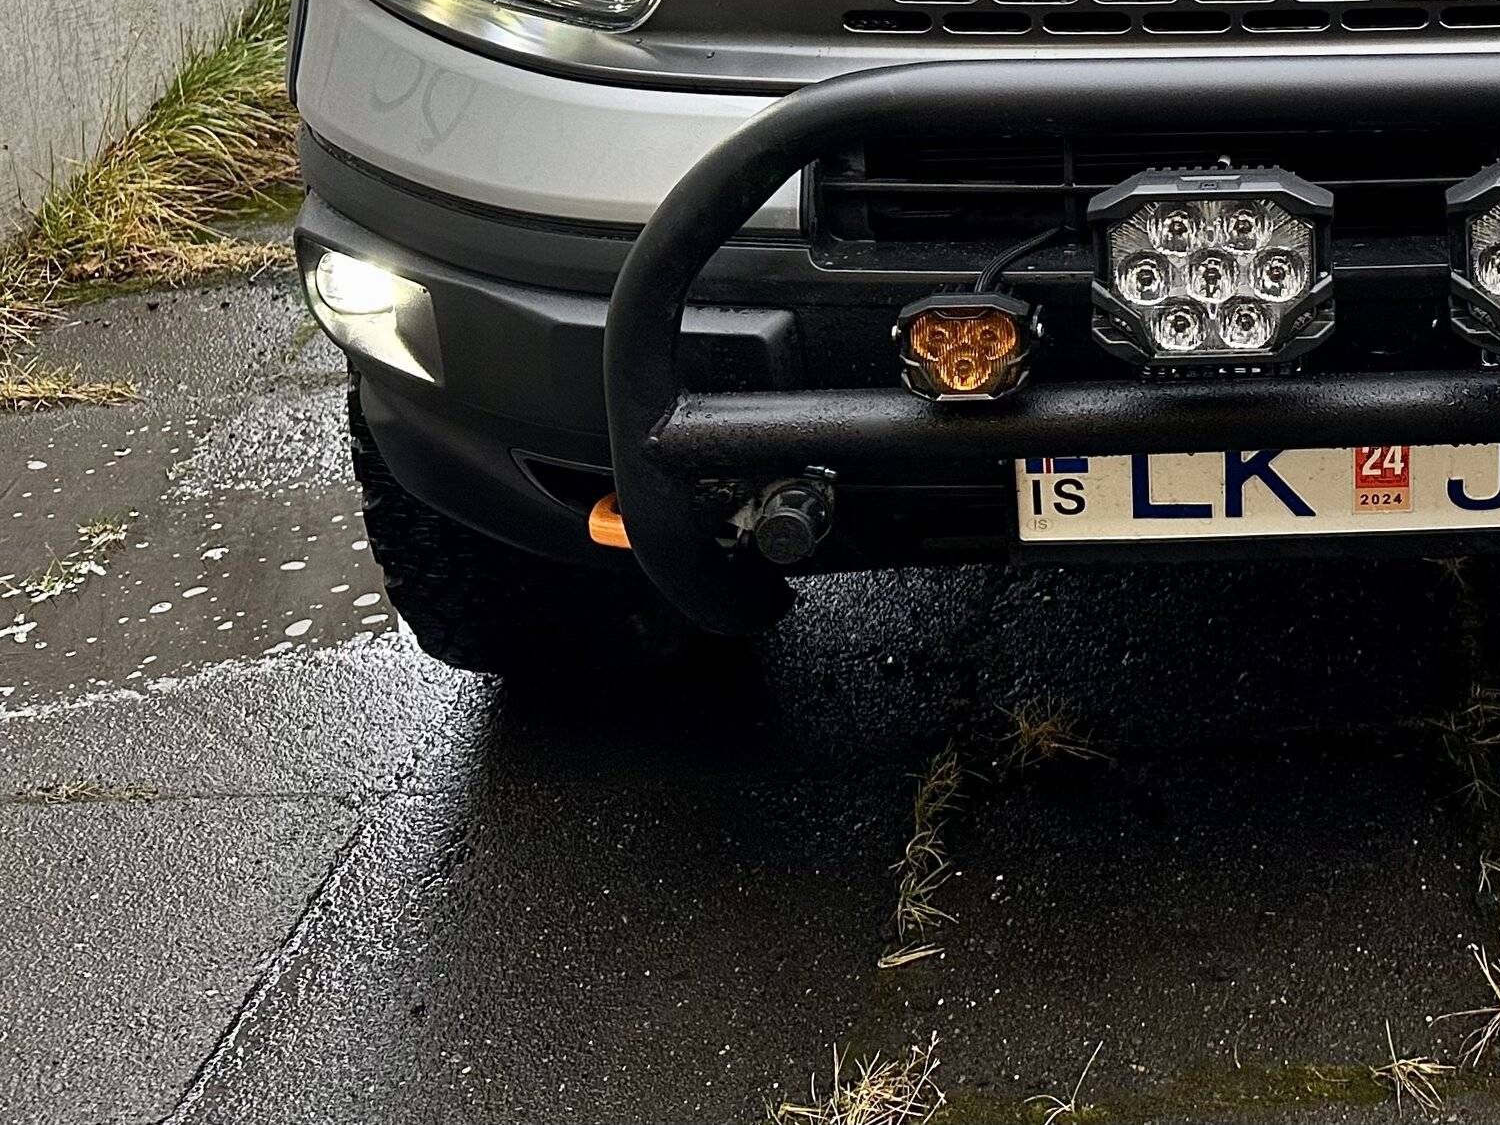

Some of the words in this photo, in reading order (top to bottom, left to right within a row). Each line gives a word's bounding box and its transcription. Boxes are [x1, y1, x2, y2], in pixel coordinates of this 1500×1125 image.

[1361, 445, 1405, 476] 24
[1032, 478, 1086, 515] IS
[1131, 450, 1316, 519] LK
[1360, 493, 1403, 505] 2024
[1033, 519, 1048, 530] IS
